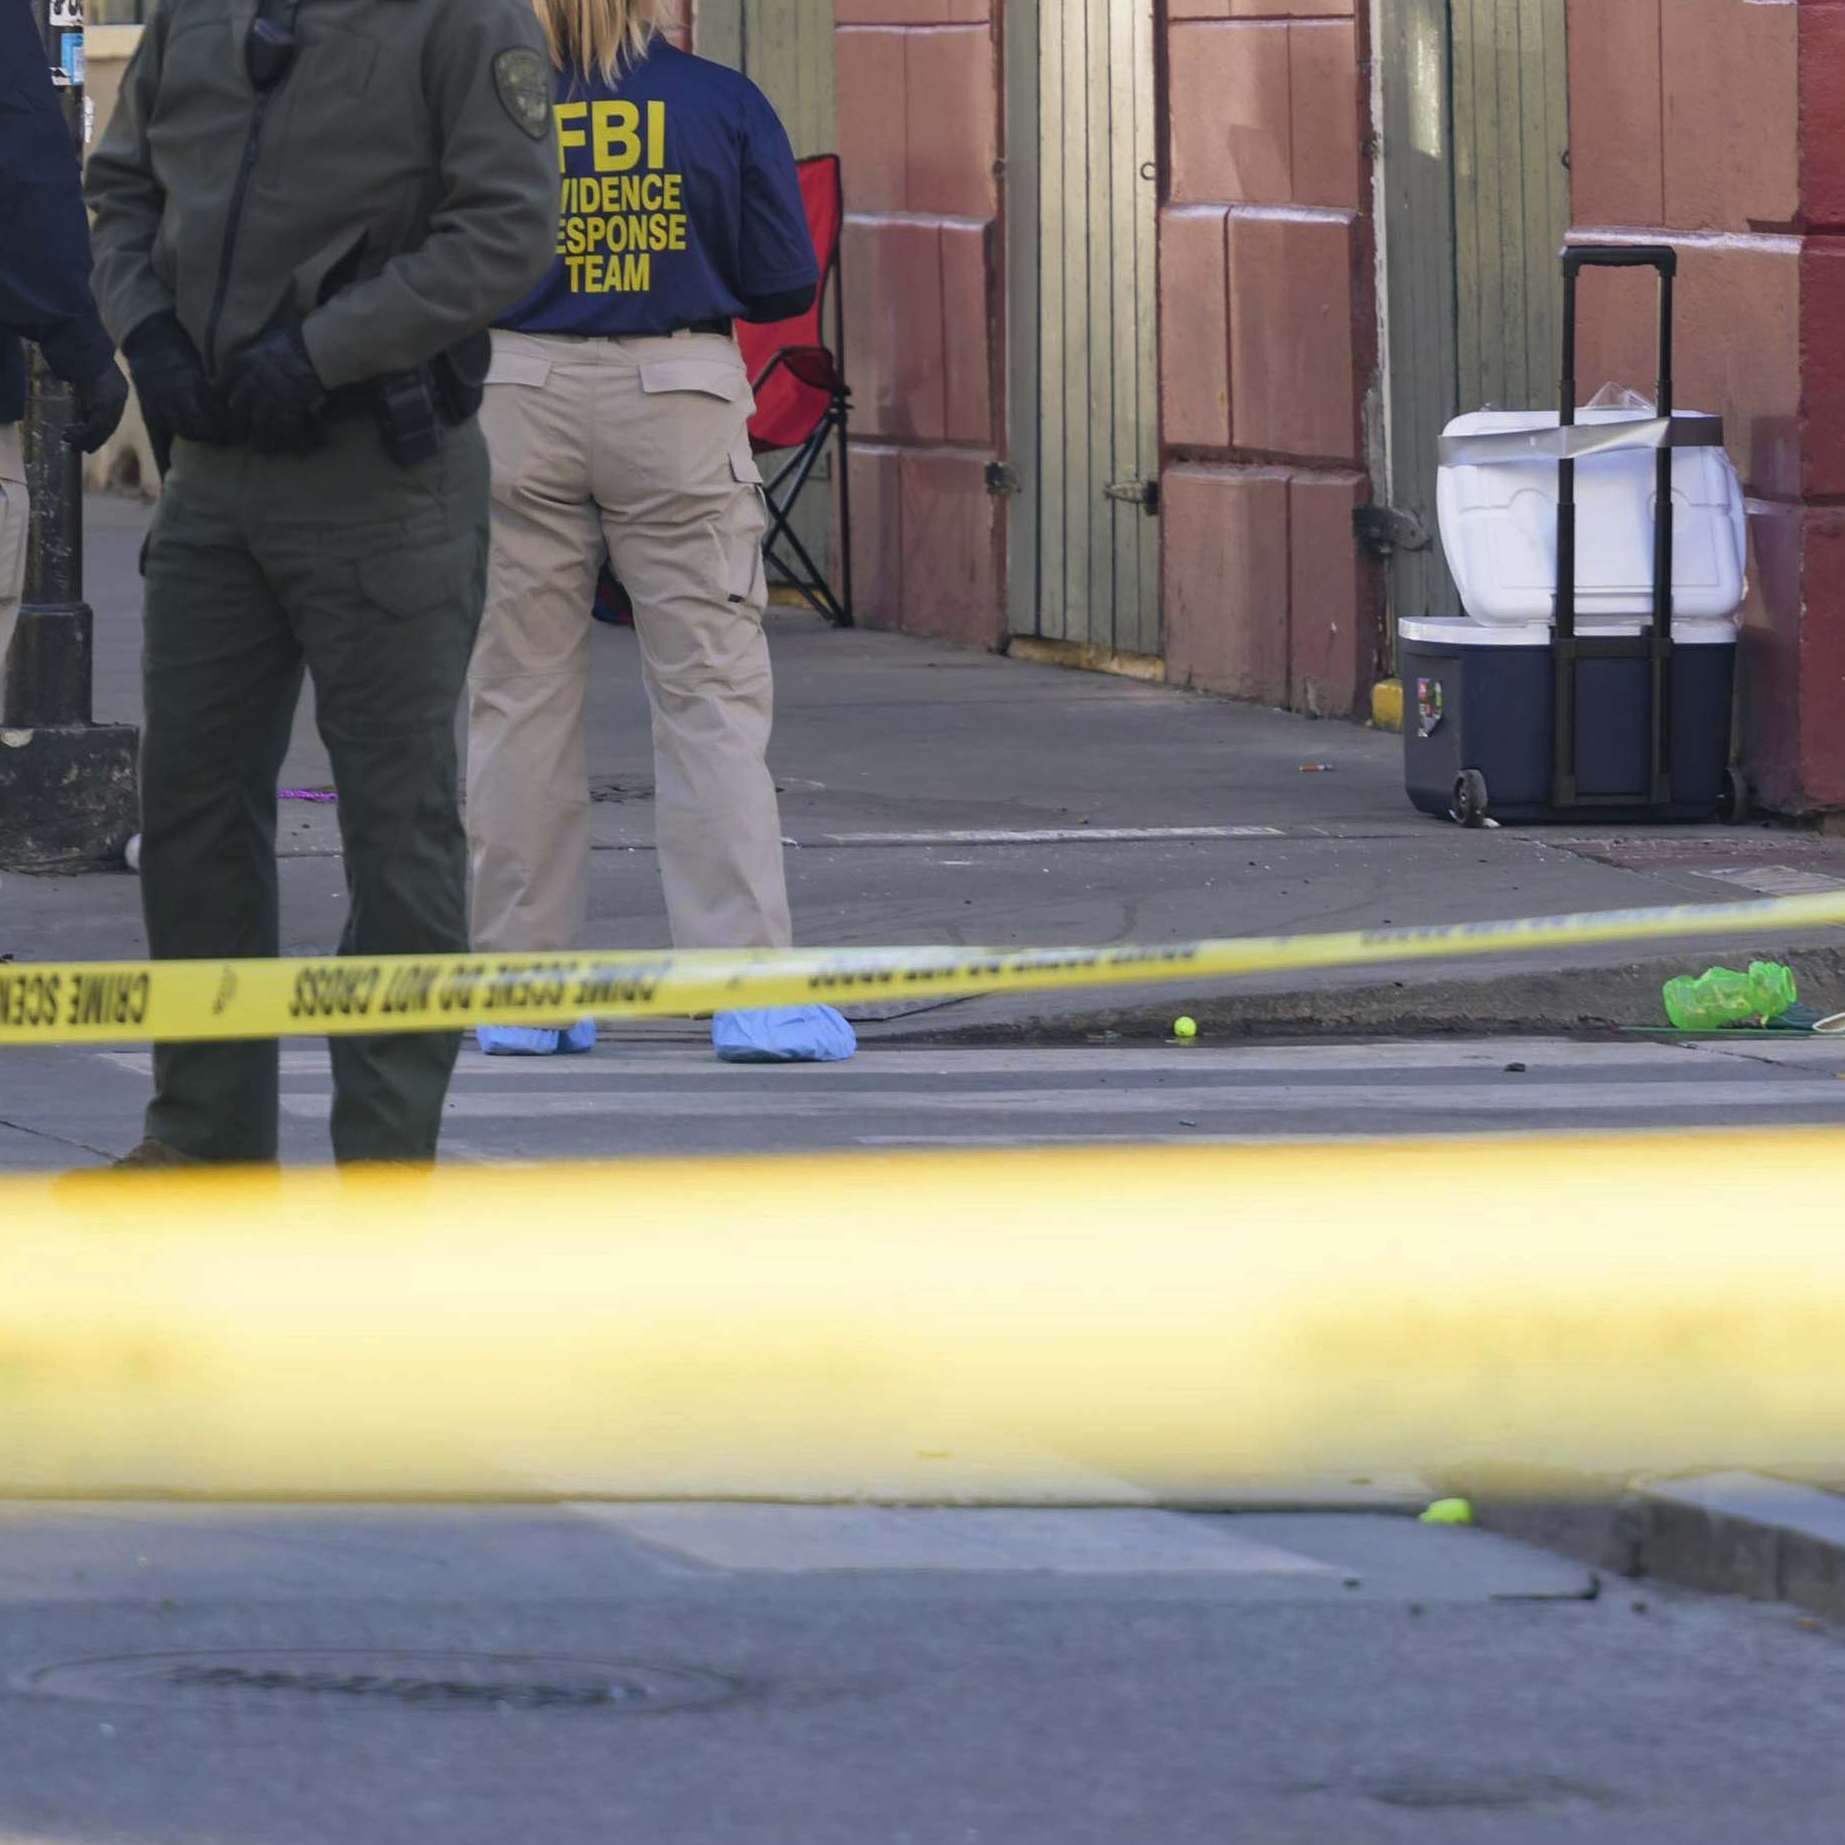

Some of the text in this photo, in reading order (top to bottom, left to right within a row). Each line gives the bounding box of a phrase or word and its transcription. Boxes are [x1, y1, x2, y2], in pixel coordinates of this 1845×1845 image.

[553, 100, 665, 174] FBI
[559, 173, 682, 215] VIDENCE
[555, 213, 687, 254] ESPONSE
[565, 253, 650, 293] TEAM
[68, 971, 150, 1025] CRIME
[289, 964, 381, 1017] CROSS
